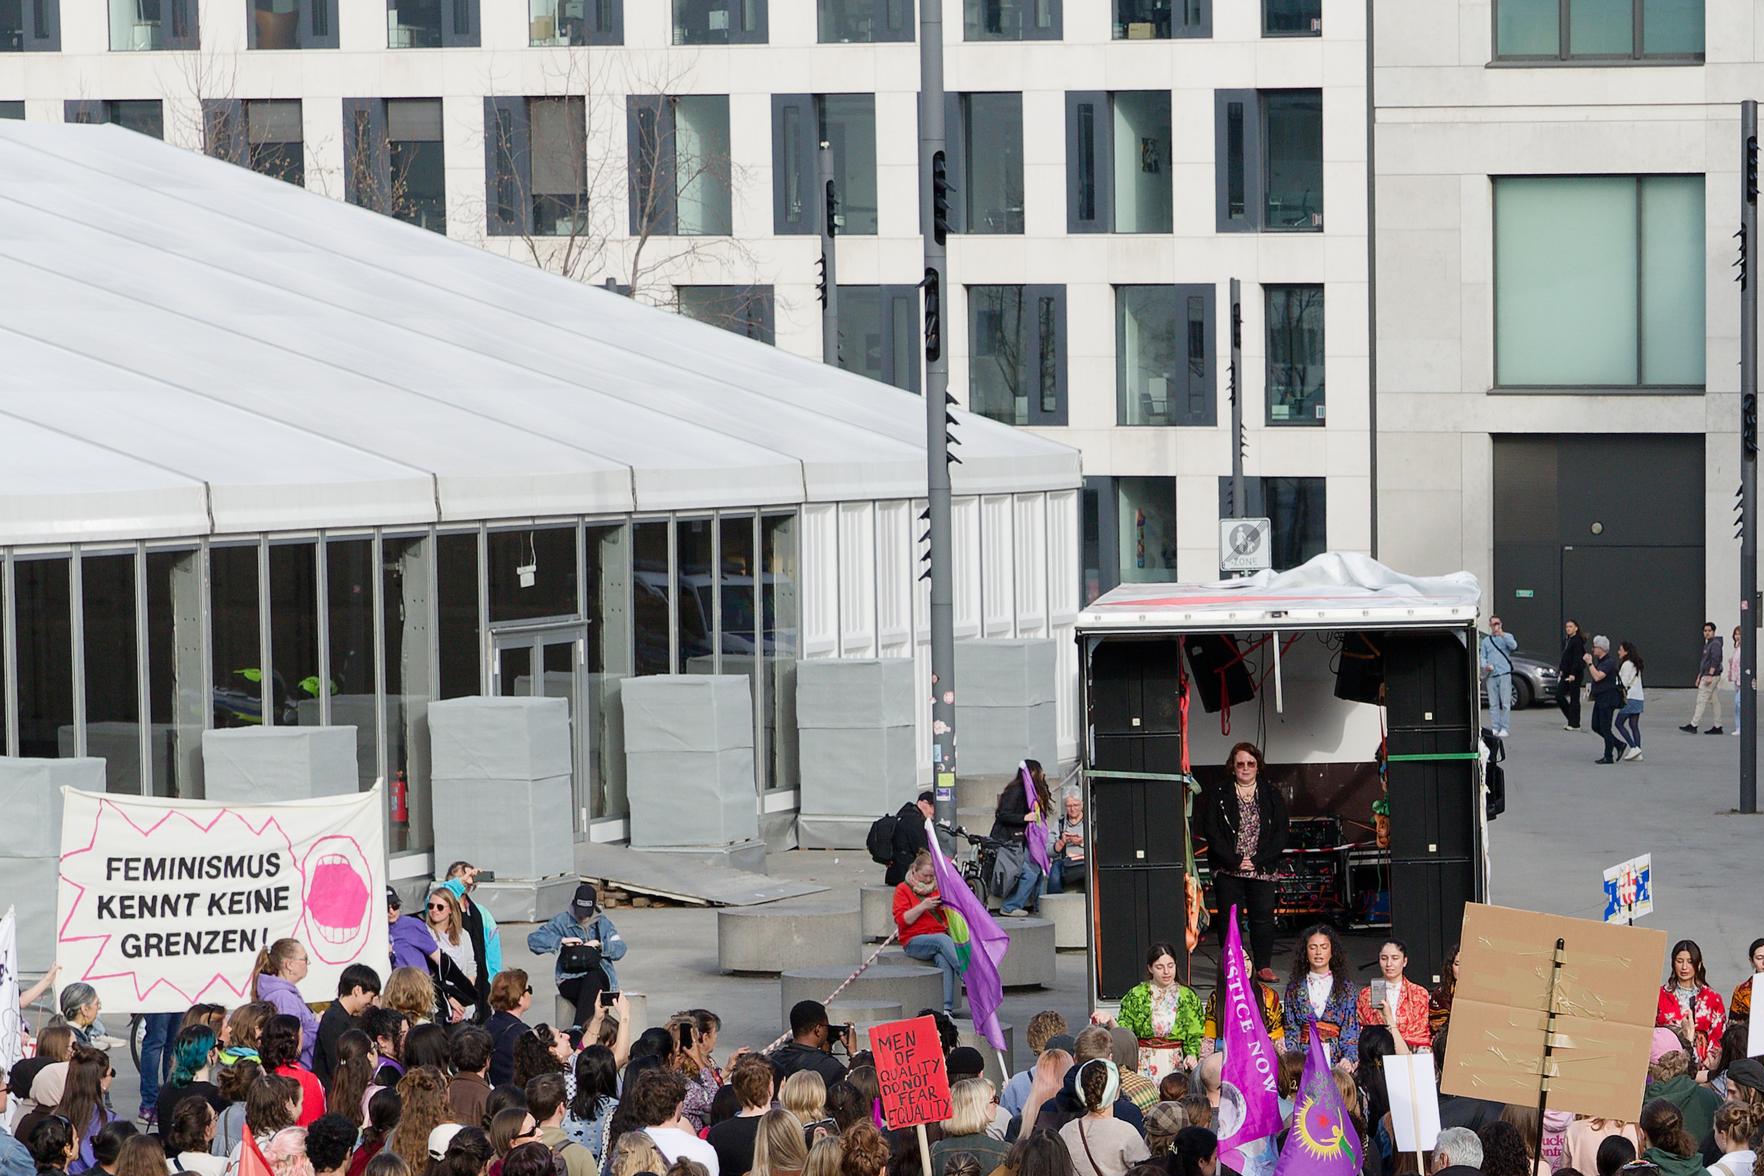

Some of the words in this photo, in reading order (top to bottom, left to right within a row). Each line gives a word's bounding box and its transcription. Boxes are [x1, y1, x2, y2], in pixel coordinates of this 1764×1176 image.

[106, 853, 281, 881] FEMINISMUS
[97, 893, 200, 919] KENNT
[207, 886, 290, 916] KEINE
[1227, 945, 1255, 1033] STICE
[1248, 1040, 1278, 1093] NOW
[878, 1030, 916, 1053] MEN
[894, 1049, 916, 1066] OF
[880, 1058, 940, 1083] QUALITY
[882, 1082, 899, 1096] DO
[902, 1073, 929, 1091] NOT
[898, 1085, 938, 1105] FEAR
[888, 1098, 950, 1128] EQUALITY
